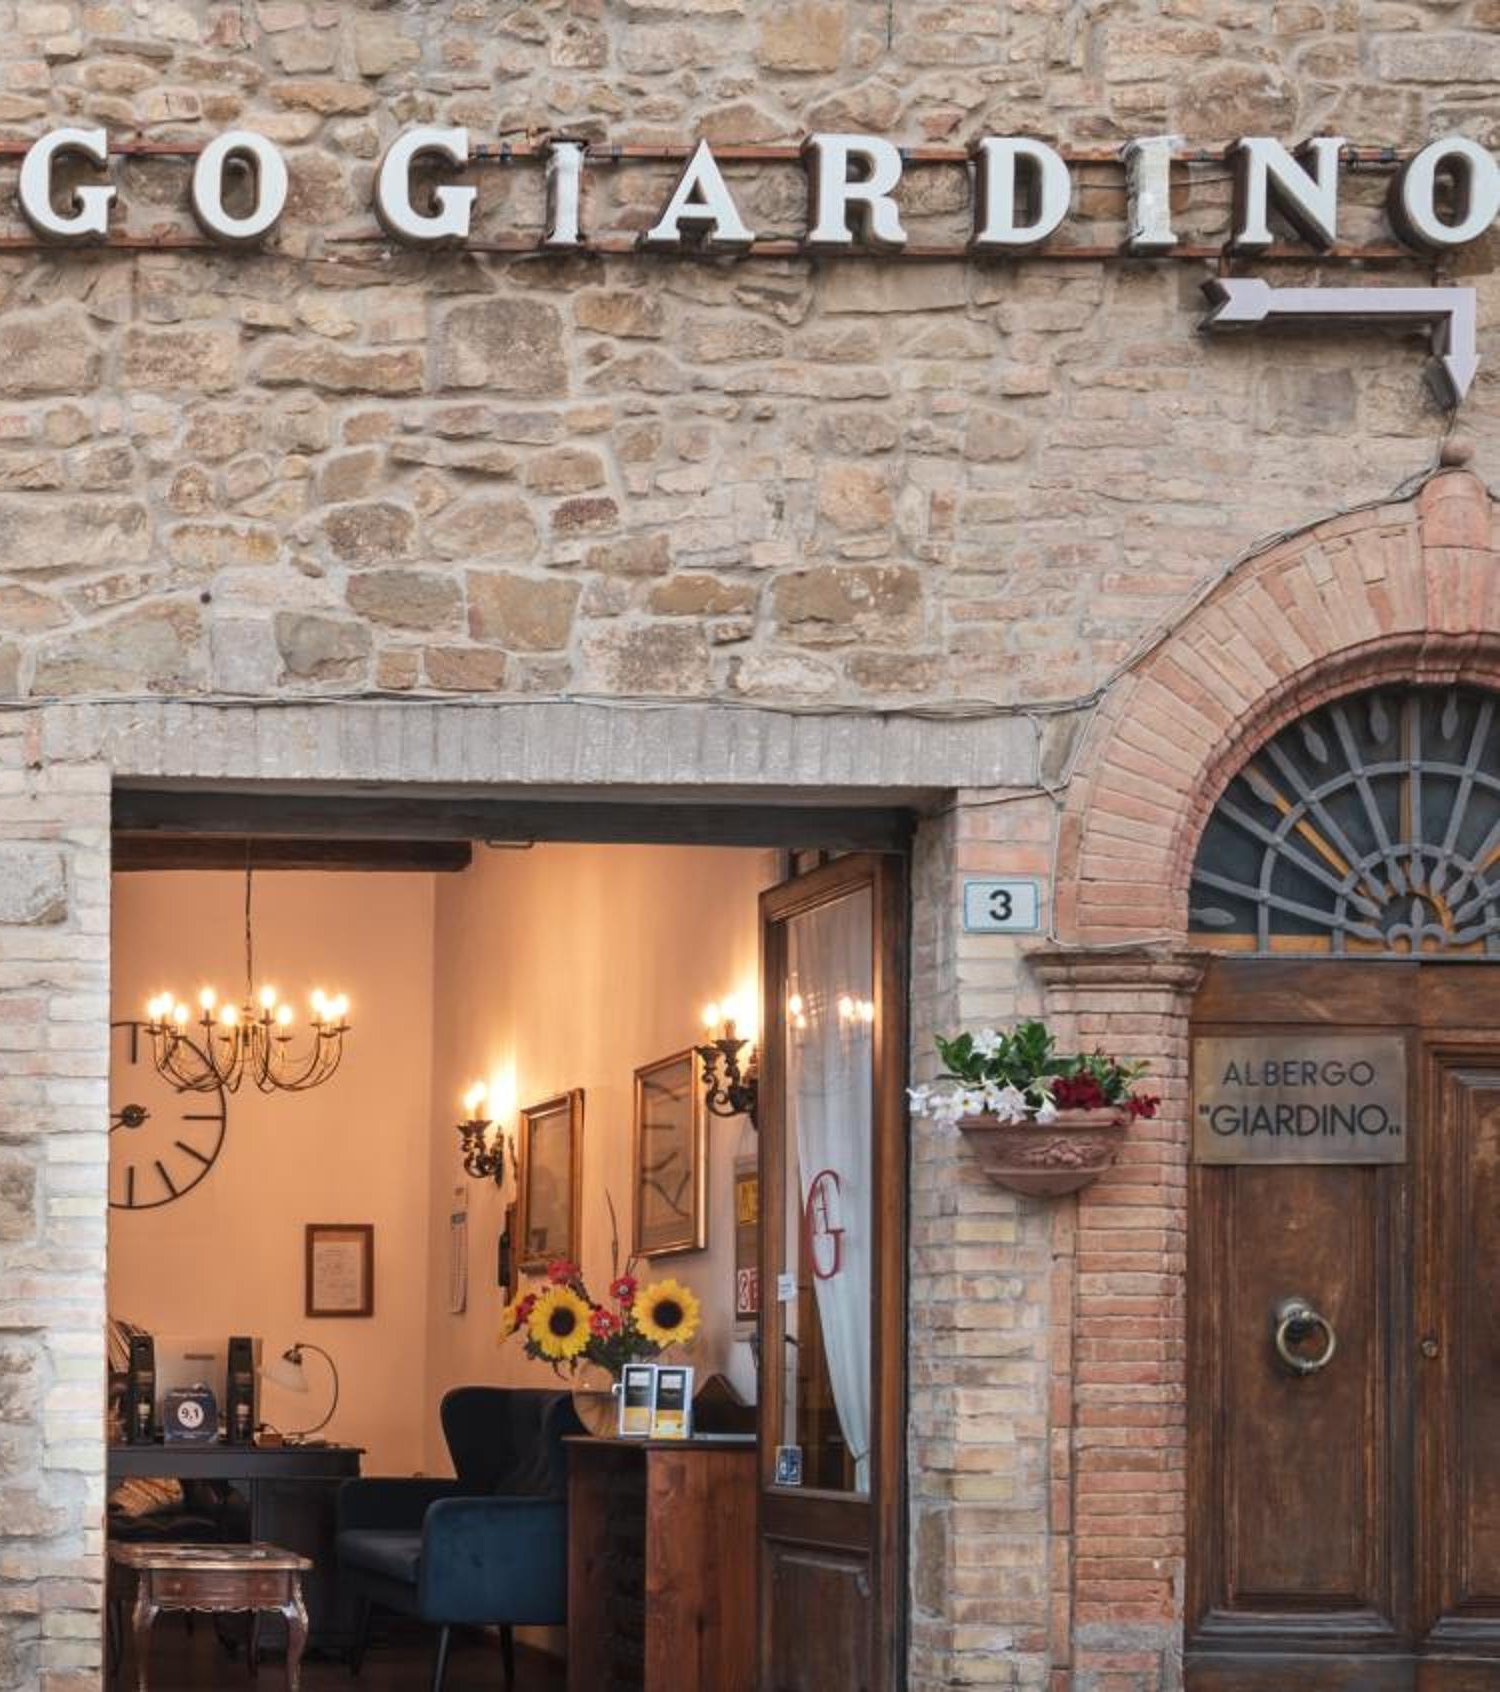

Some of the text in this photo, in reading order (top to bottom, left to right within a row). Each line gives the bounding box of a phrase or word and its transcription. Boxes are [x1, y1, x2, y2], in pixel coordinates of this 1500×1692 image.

[376, 127, 1500, 246] GIARDINO
[989, 889, 1012, 921] 3
[1222, 1060, 1376, 1087] ALBERGO
